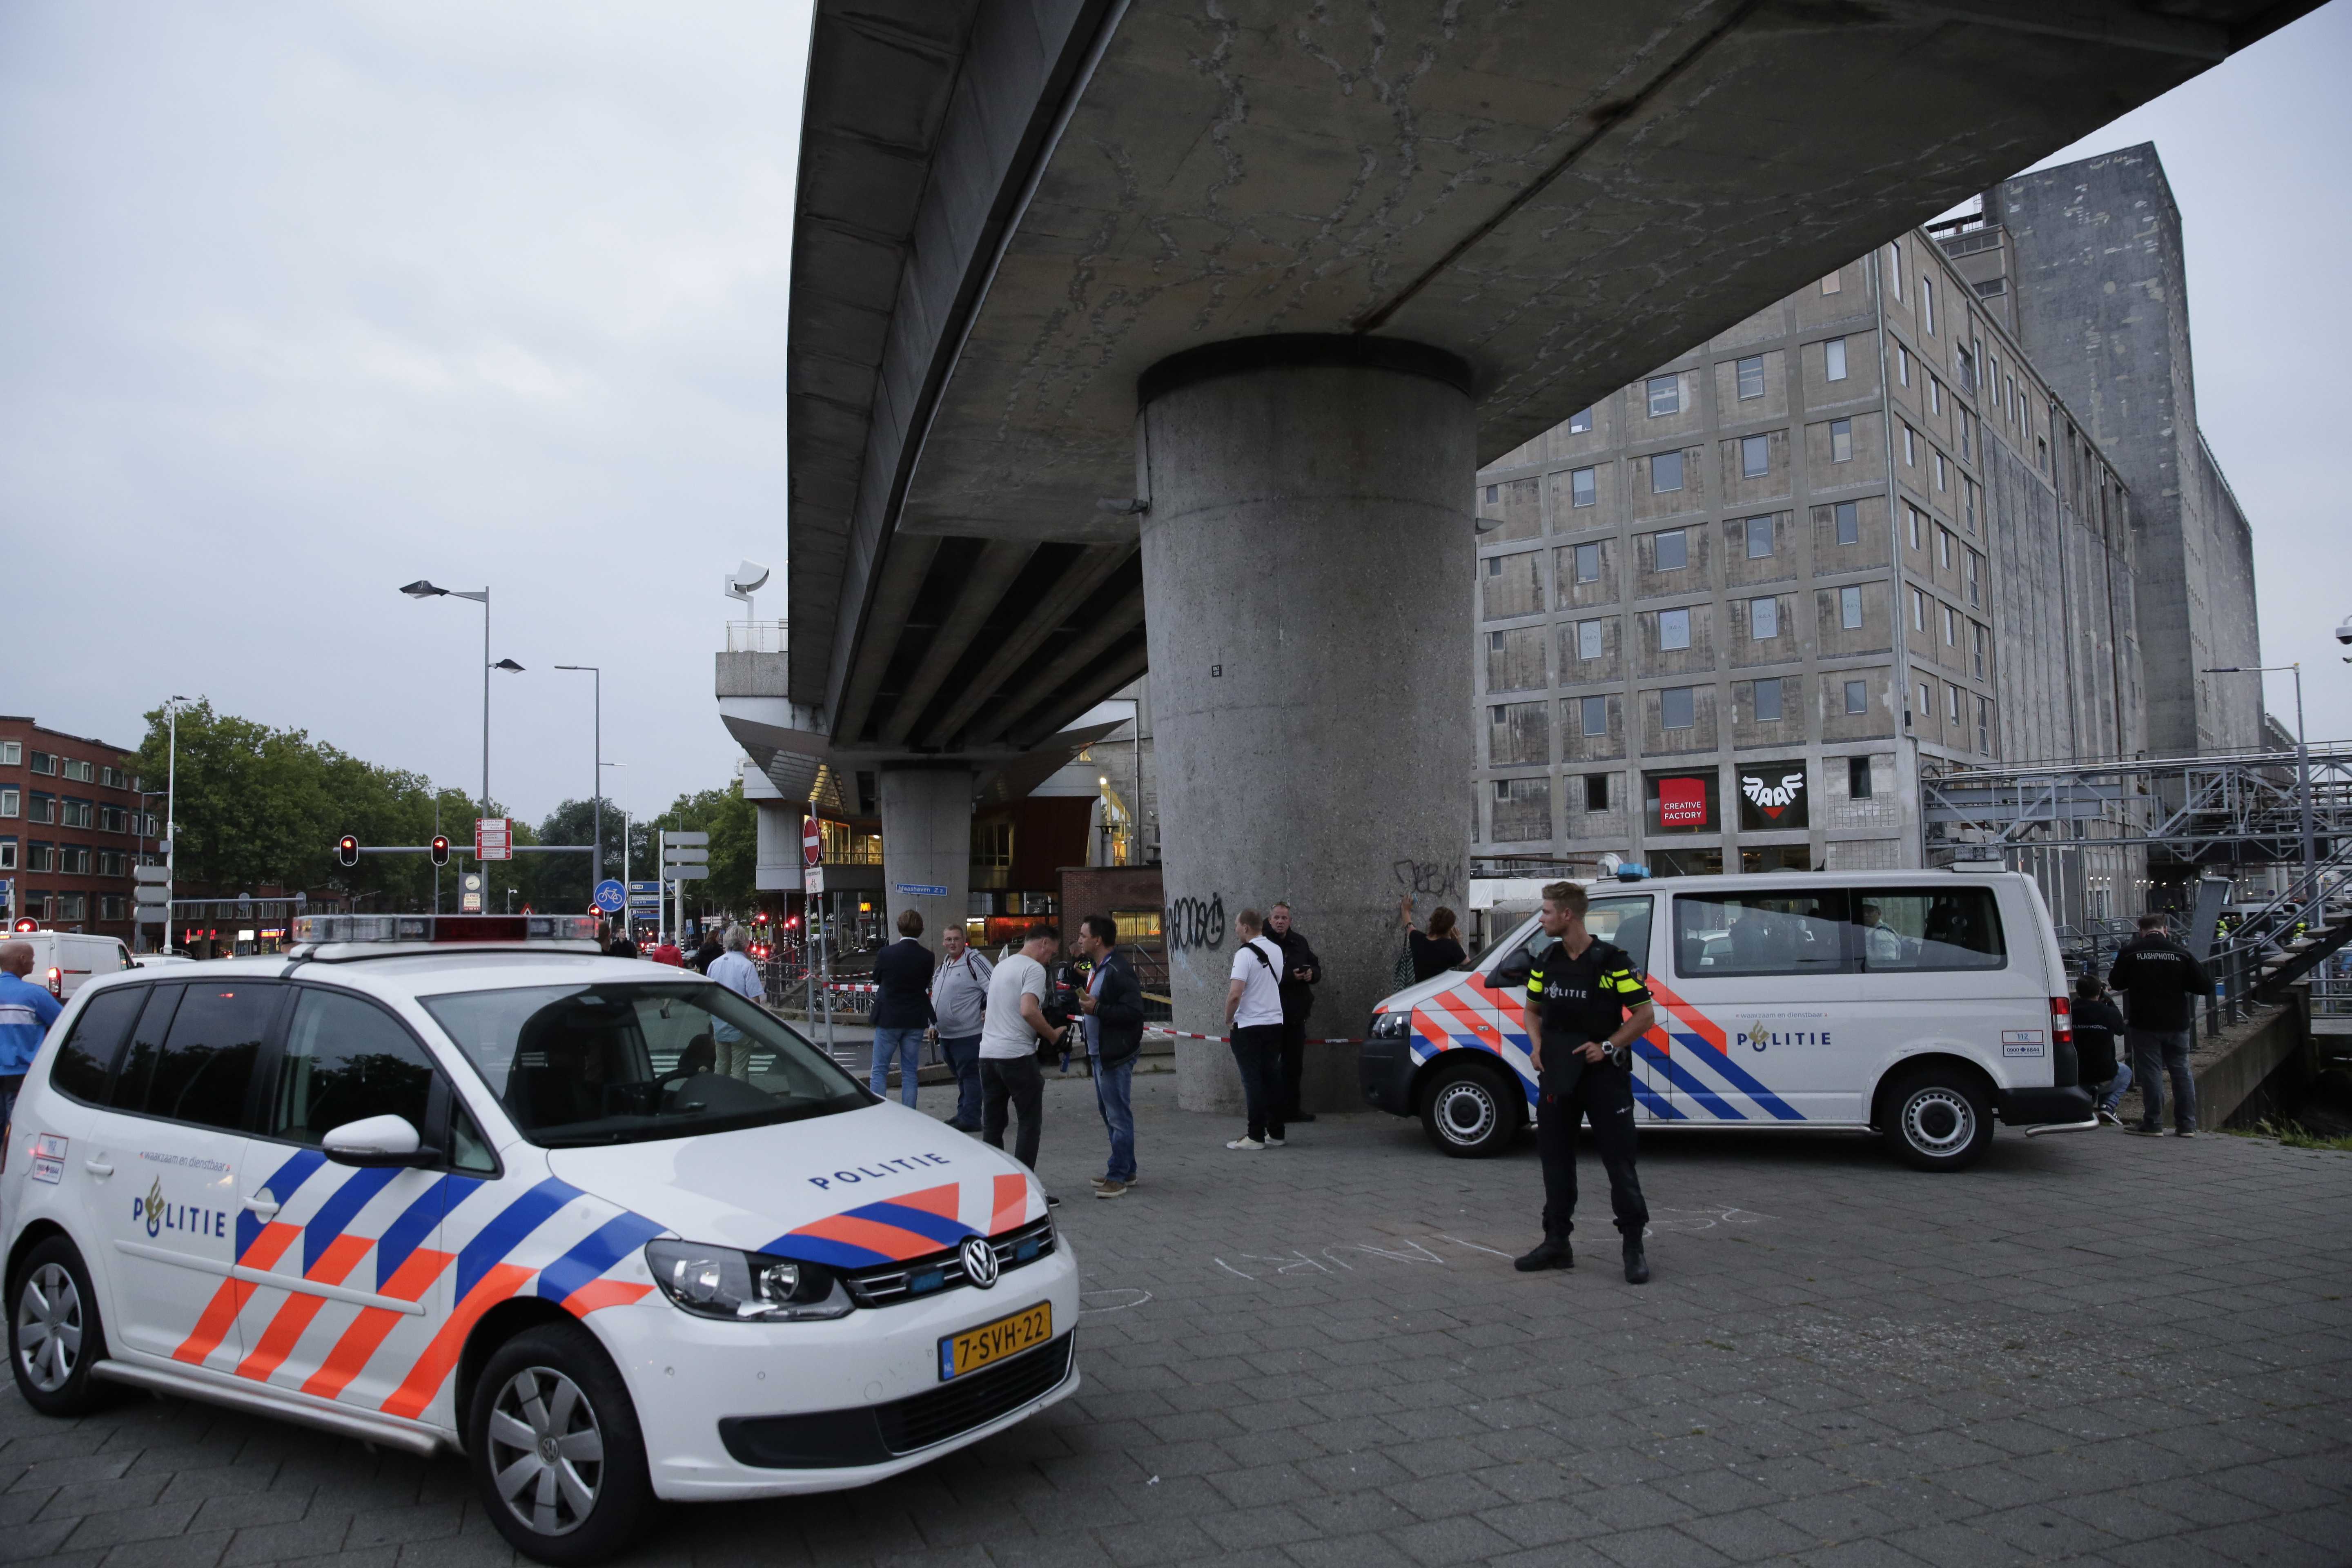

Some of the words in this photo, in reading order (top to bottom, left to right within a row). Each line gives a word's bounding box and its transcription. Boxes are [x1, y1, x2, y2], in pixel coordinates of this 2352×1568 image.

[1664, 801, 1702, 811] CREATIVE
[1664, 811, 1702, 820] FACTORY
[2136, 953, 2175, 961] FLASHPHOTO
[1544, 987, 1587, 999] POLITIE
[1737, 1032, 1831, 1052] POLITIE
[144, 1152, 178, 1164] waakzaam
[179, 1156, 188, 1166] en
[189, 1155, 227, 1172] dienstbaar
[807, 1152, 951, 1190] POLITIE
[133, 1196, 226, 1238] POLITIE
[959, 1311, 1044, 1368] 7-SVH-22
[944, 1361, 953, 1372] NL
